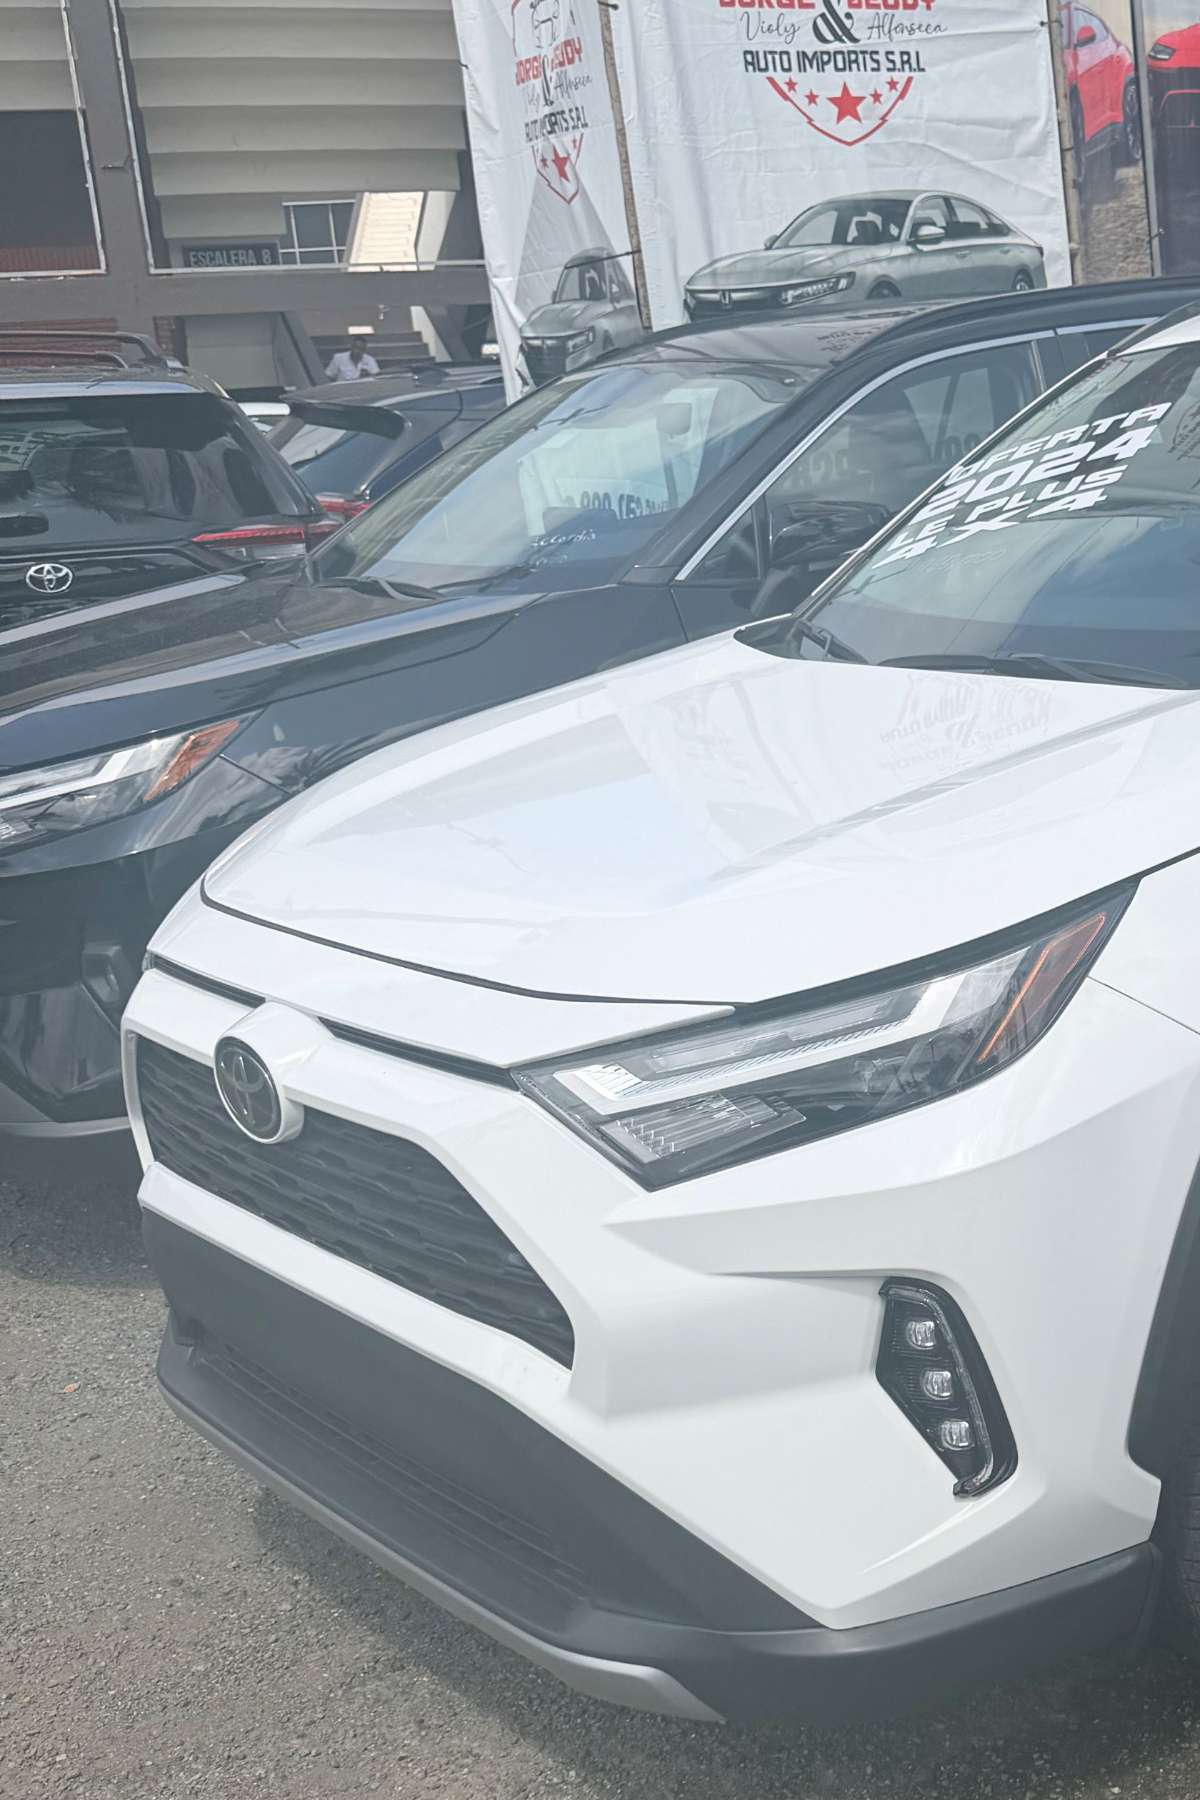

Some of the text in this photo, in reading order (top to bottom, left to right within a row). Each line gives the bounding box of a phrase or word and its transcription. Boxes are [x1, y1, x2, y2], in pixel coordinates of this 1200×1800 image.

[812, 0, 861, 44] &
[515, 54, 541, 86] JORG
[743, 50, 791, 73] AUTO
[797, 50, 881, 73] IMPORTS
[190, 249, 272, 266] ESCALERA 8
[945, 402, 1173, 486] OFERTA
[908, 425, 1158, 525] 2024
[887, 465, 1128, 551] LE PLUS
